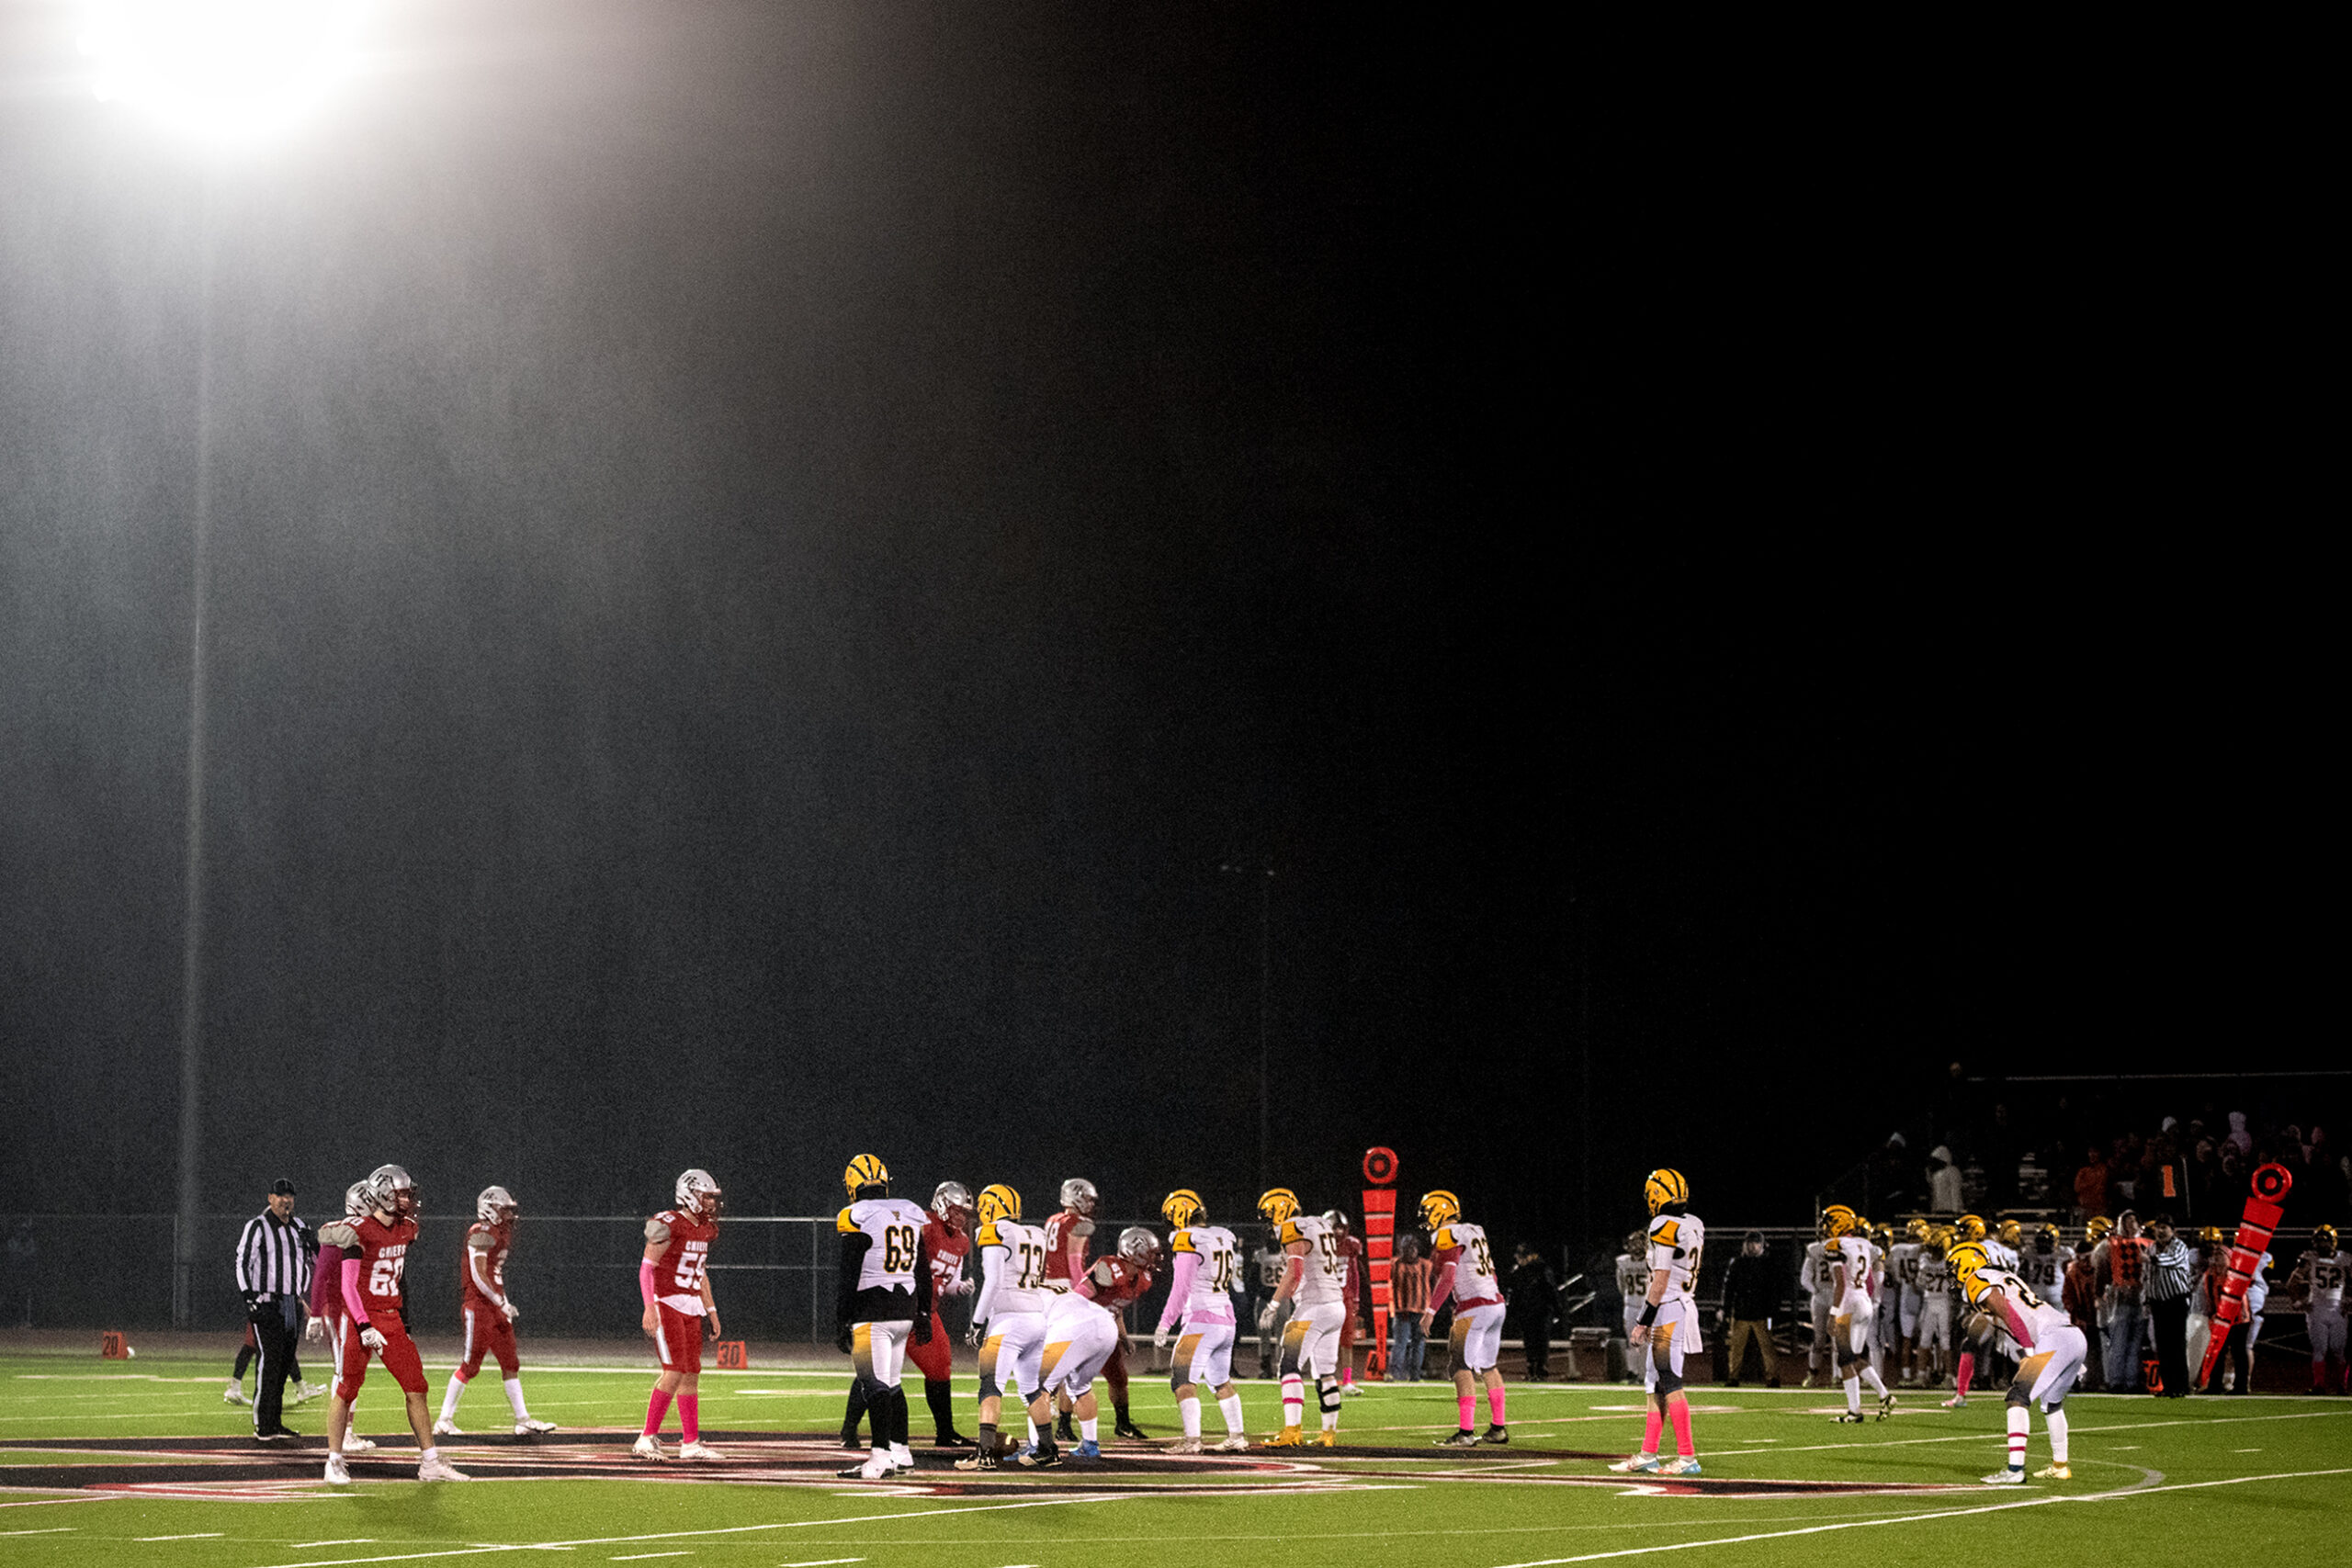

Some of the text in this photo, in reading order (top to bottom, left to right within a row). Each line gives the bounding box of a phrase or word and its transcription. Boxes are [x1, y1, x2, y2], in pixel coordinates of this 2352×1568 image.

[884, 1224, 915, 1274] 69
[1681, 1247, 1704, 1292] 3
[2315, 1266, 2342, 1289] 52
[103, 1336, 119, 1356] 20
[718, 1344, 741, 1367] 30
